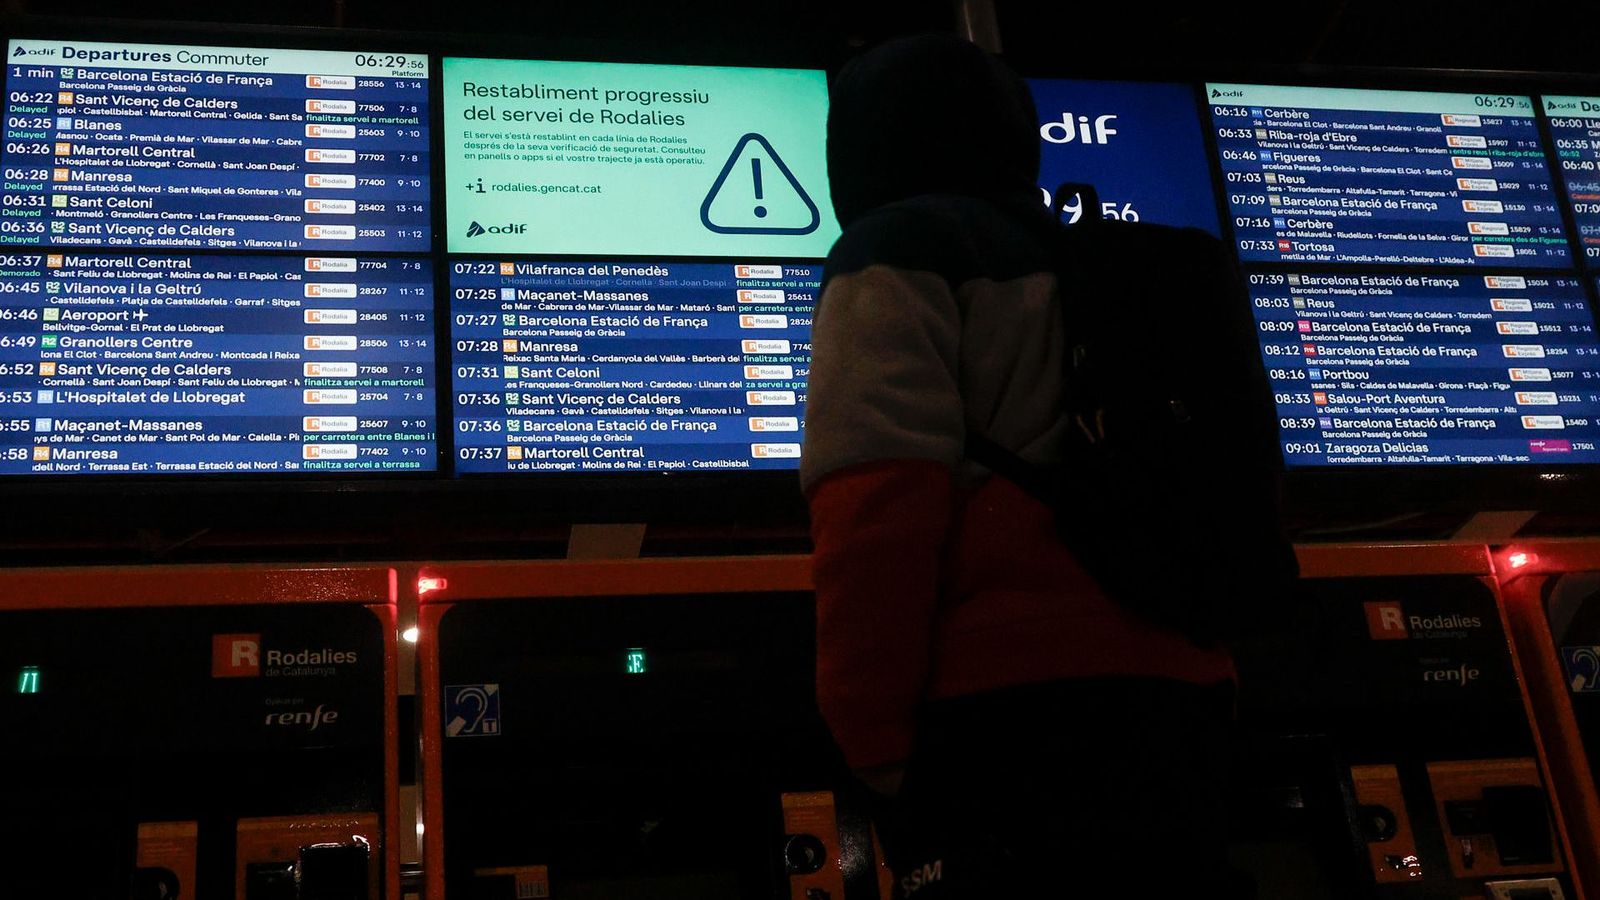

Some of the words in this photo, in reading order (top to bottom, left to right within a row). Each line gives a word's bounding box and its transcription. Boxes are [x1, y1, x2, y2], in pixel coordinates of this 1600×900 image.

[62, 46, 171, 62] Departures
[177, 50, 269, 66] Commuter
[13, 67, 22, 77] 1
[28, 68, 54, 78] min
[77, 69, 148, 81] Barcelona
[152, 72, 202, 83] Estació
[206, 74, 223, 84] de
[227, 74, 273, 87] França
[59, 82, 105, 90] Barcelona
[107, 83, 142, 92] Passeig
[463, 82, 599, 100] Restabliment
[605, 90, 709, 105] progressiu
[10, 92, 53, 103] 06:22
[76, 94, 108, 105] Sant
[111, 95, 159, 108] Vicenç
[163, 97, 181, 107] de
[184, 98, 238, 109] Calders
[9, 105, 48, 113] Delayed
[464, 105, 496, 120] del
[502, 108, 563, 122] servei
[569, 109, 594, 123] de
[601, 109, 685, 126] Rodalies
[1215, 106, 1248, 116] 06:16
[1264, 109, 1309, 119] Cerbère
[8, 117, 51, 128] 06:25
[74, 119, 122, 130] Blanes
[1040, 112, 1117, 144] dif
[8, 131, 46, 139] Delayed
[463, 131, 473, 139] El
[650, 136, 687, 144] Rodalies
[1219, 128, 1252, 138] 06:33
[1269, 130, 1320, 142] Riba-roja
[1322, 132, 1357, 142] d'Ebre
[7, 143, 50, 154] 06:26
[73, 145, 139, 156] Martorell
[142, 146, 195, 158] Central
[464, 141, 501, 150] després
[550, 144, 598, 152] verificació
[661, 146, 706, 154] Consulteu
[597, 156, 633, 164] trajecte
[634, 156, 642, 165] ja
[1223, 150, 1257, 160] 06:46
[1273, 152, 1321, 163] Figueres
[5, 169, 48, 180] 06:28
[71, 171, 132, 182] Manresa
[1227, 172, 1261, 182] 07:03
[1278, 174, 1305, 184] Reus
[4, 182, 43, 191] Delayed
[492, 182, 601, 194] rodalies.gencat.cat
[3, 195, 46, 206] 06:31
[70, 196, 103, 207] Sant
[107, 197, 153, 208] Celoni
[1232, 195, 1265, 204] 07:09
[1282, 196, 1339, 207] Barcelona
[1341, 198, 1382, 208] Estació
[1384, 199, 1398, 209] de
[1400, 200, 1438, 212] França
[2, 209, 41, 217] Delayed
[488, 224, 527, 234] adif
[1240, 240, 1275, 250] 07:33
[1291, 241, 1335, 252] Tortosa
[0, 255, 42, 266] 06:37
[65, 256, 133, 268] Martorell
[137, 257, 191, 268] Central
[455, 263, 495, 274] 07:22
[516, 264, 585, 275] Vilafranca
[588, 265, 610, 276] del
[613, 265, 668, 276] Penedès
[63, 282, 126, 294] Vilanova
[138, 283, 151, 294] la
[155, 284, 201, 295] Geltrú
[455, 289, 496, 300] 07:25
[518, 290, 649, 302] Maçanet-Massanes
[61, 310, 129, 322] Aeroport
[456, 315, 497, 326] 07:27
[519, 315, 587, 326] Barcelona
[591, 316, 640, 326] Estació
[643, 316, 660, 326] de
[663, 316, 708, 329] França
[43, 323, 123, 332] Bellvitge-Gornal
[178, 324, 224, 333] Llobregat
[549, 329, 582, 338] Passeig
[60, 336, 138, 348] Granollers
[142, 337, 193, 348] Centre
[1270, 369, 1305, 379] 08:16
[1322, 369, 1369, 380] Portbou
[56, 391, 146, 405] L'Hospitalet
[150, 391, 169, 403] de
[173, 391, 245, 405] Llobregat
[1275, 394, 1311, 404] 08:33
[1328, 394, 1392, 404] Salou-Port
[1394, 394, 1446, 404] Aventura
[54, 420, 203, 433] Maçanet-Massanes
[460, 448, 502, 459] 07:37
[525, 447, 590, 458] Martorell
[593, 447, 645, 458] Central
[1286, 443, 1322, 453] 09:01
[1325, 443, 1381, 455] Zaragoza
[1382, 442, 1429, 453] Delicias
[1409, 614, 1481, 630] Rodalies
[232, 640, 258, 667] R
[267, 648, 357, 666] Rodalies
[1424, 664, 1479, 686] renfe
[265, 704, 338, 731] renfe
